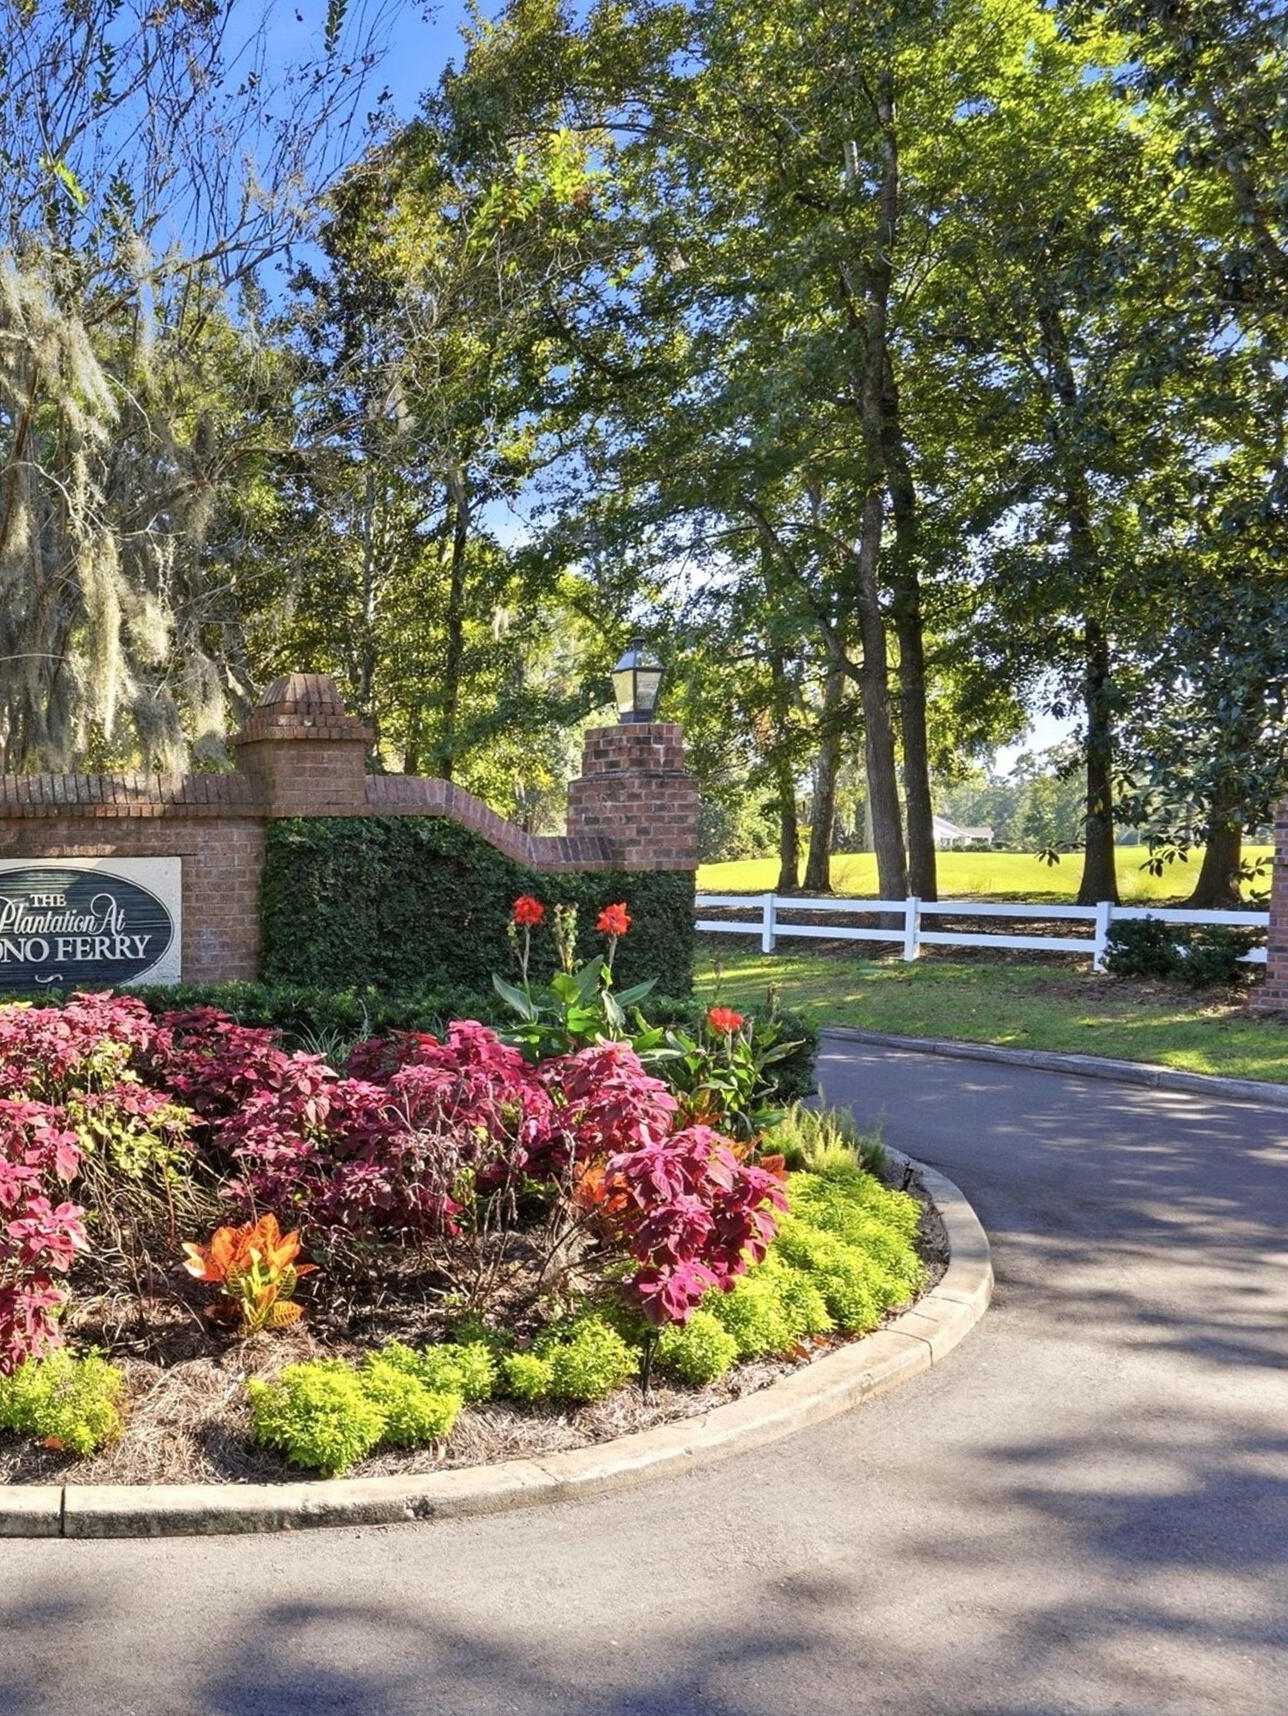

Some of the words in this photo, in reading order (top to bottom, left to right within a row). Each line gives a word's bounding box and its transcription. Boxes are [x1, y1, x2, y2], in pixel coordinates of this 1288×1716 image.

[29, 893, 67, 908] THE
[90, 893, 127, 936] At
[54, 934, 153, 962] FERRY
